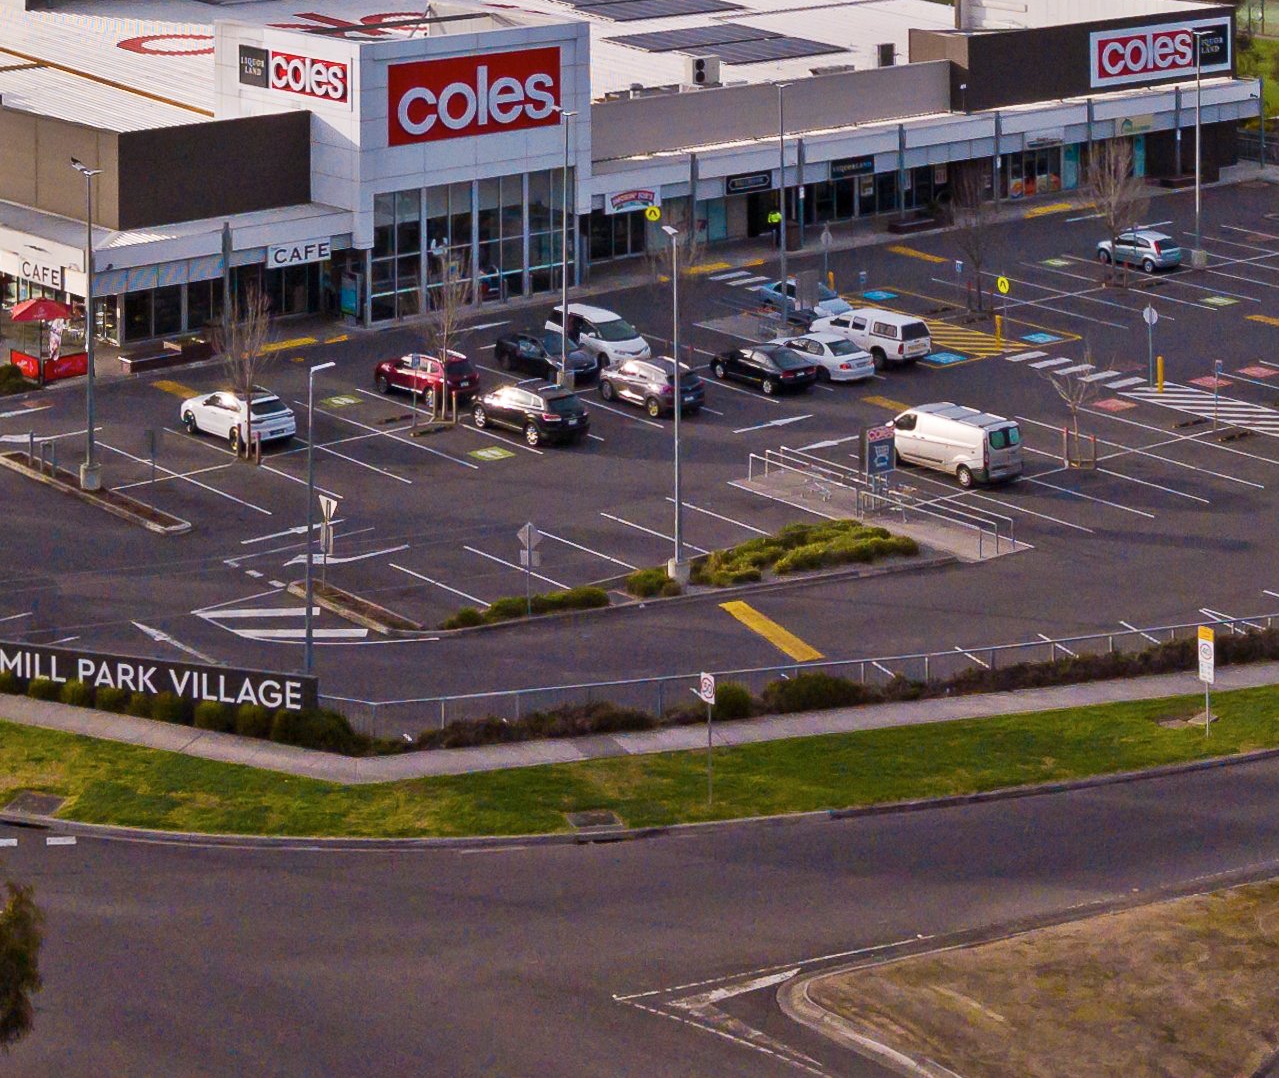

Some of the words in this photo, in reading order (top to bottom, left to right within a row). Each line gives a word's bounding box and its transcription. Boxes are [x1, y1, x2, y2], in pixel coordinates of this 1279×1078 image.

[240, 56, 265, 67] LIQUOR
[245, 65, 262, 75] LAND
[1102, 33, 1193, 75] coles
[271, 56, 344, 99] coles
[397, 65, 555, 135] coles
[274, 242, 330, 264] CAFE
[22, 261, 60, 287] CAFE
[0, 648, 66, 682] MILL
[78, 658, 158, 694] PARK
[168, 668, 302, 710] VILLAGE
